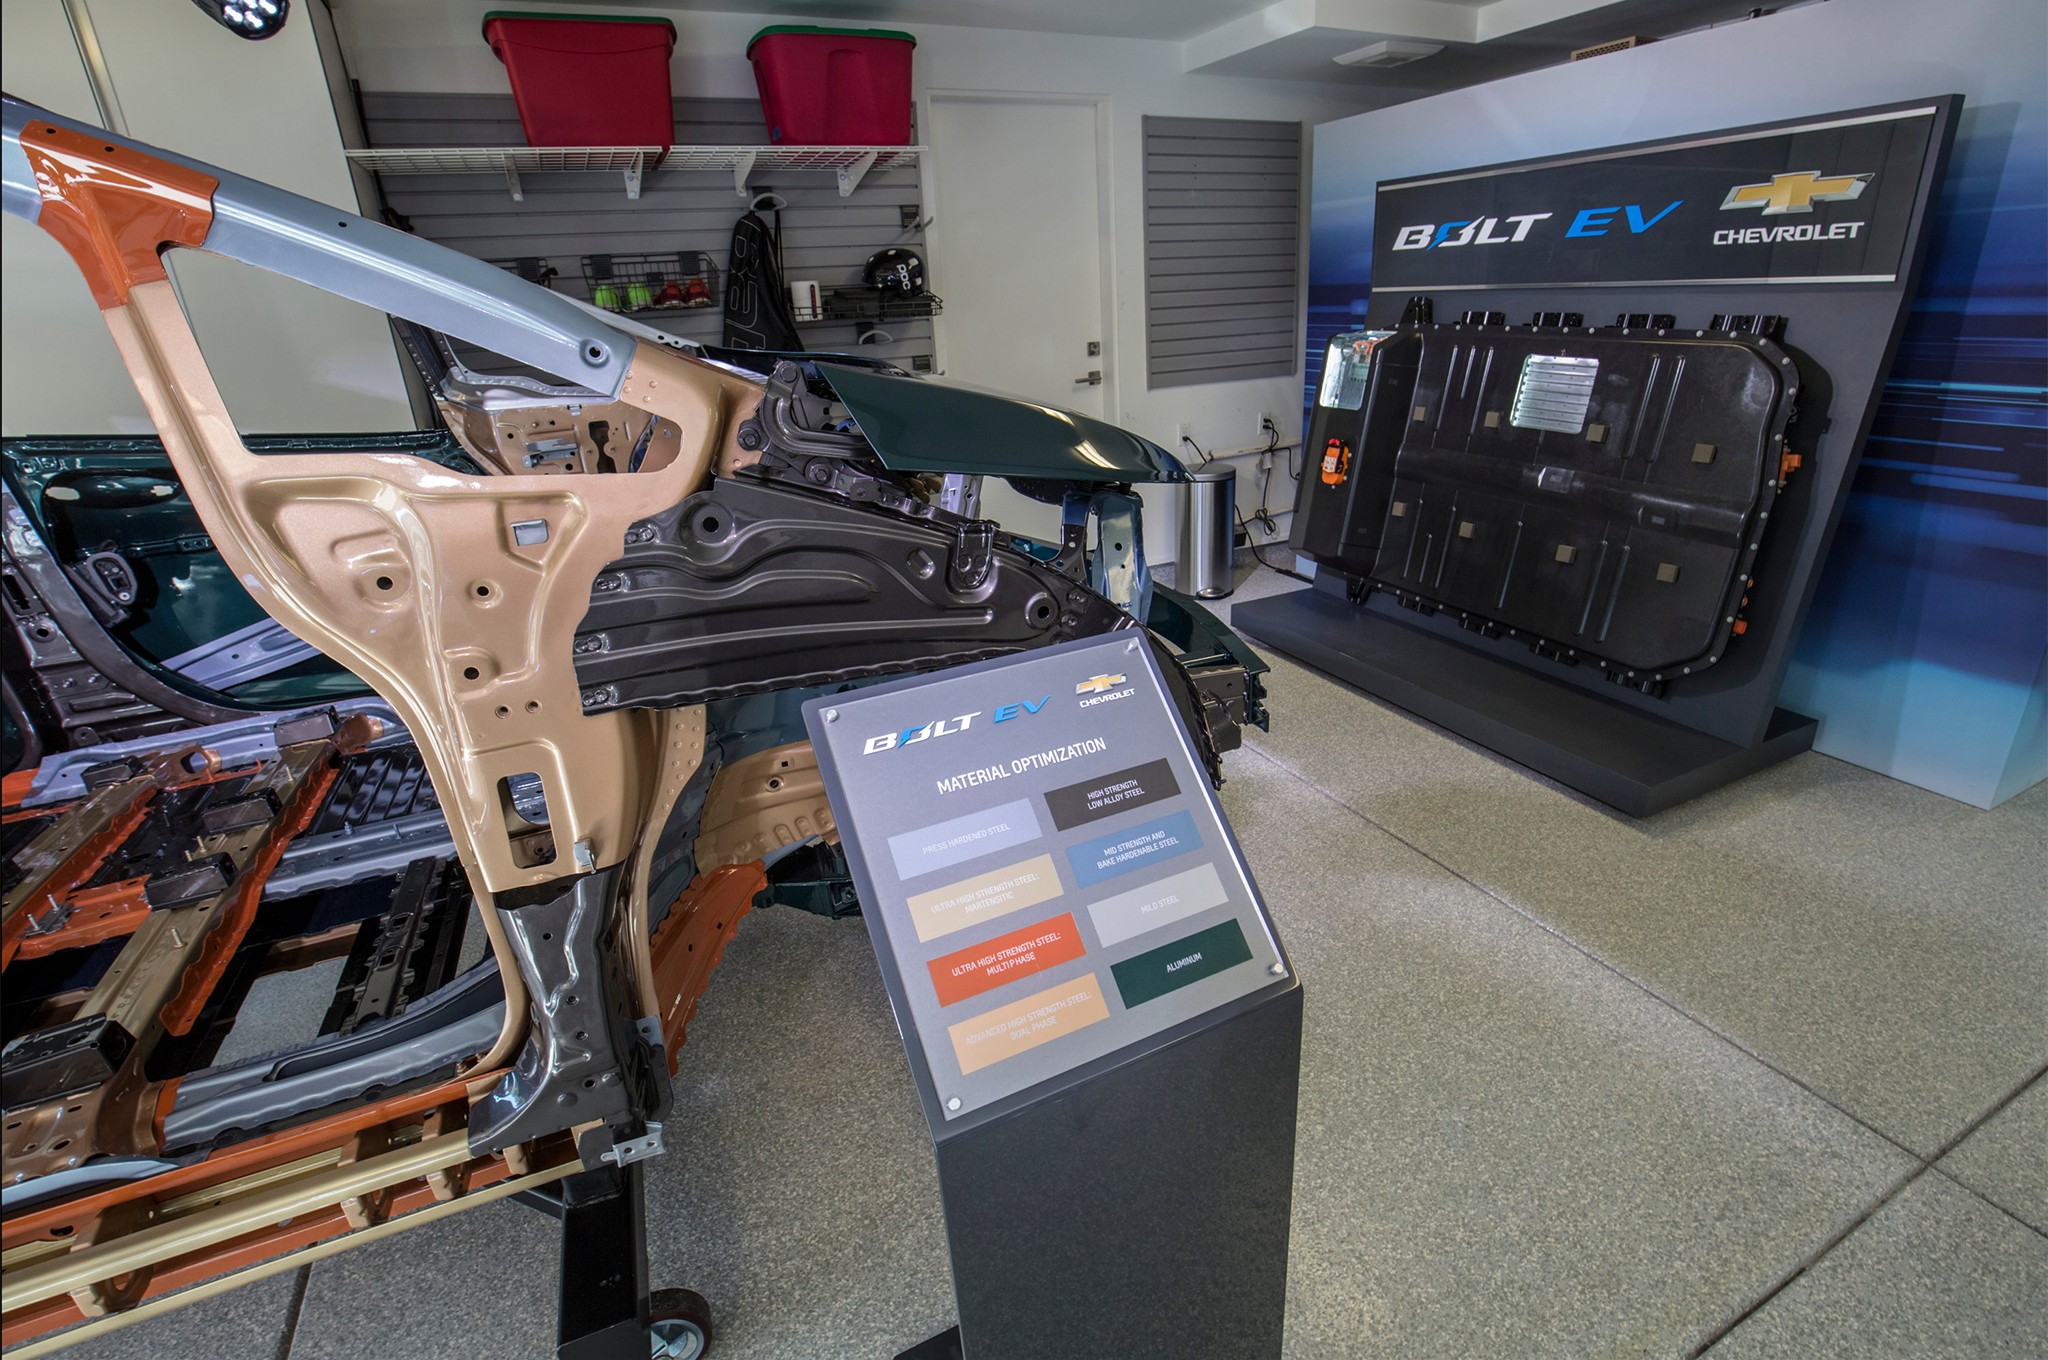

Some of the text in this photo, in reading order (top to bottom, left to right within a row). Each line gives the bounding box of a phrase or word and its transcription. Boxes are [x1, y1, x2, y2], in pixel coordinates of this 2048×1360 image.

[1392, 200, 1684, 252] BOLT EV
[1713, 221, 1865, 246] CHEVROLET
[1079, 688, 1135, 708] CHEVROLET
[863, 694, 1051, 756] BOLT EV
[936, 737, 1107, 796] MATERIAL OPTIMIZATION
[1087, 779, 1138, 800] HIGH STRENGTH
[1087, 787, 1145, 811] LOW ALLOY STEEL
[922, 823, 1011, 855] PRESS HARDENED STEEL
[1103, 830, 1166, 856] MID STRENGTH AND
[1097, 836, 1179, 870] BAKE HARDENABLE STEEL
[931, 873, 1039, 914] ULTRA HIGH STRENGTH STEEL:
[965, 891, 1014, 914] MARTENSITIC
[1140, 895, 1179, 914] MILD STEEL
[952, 932, 1061, 977] ULTRA HIGH STRENGTH STEEL:
[1166, 952, 1202, 973] ALUMINUM
[966, 991, 1091, 1046] ADVANCED HIGH STRENGTH STEEL:
[1010, 1016, 1058, 1042] DUAL PHASE
